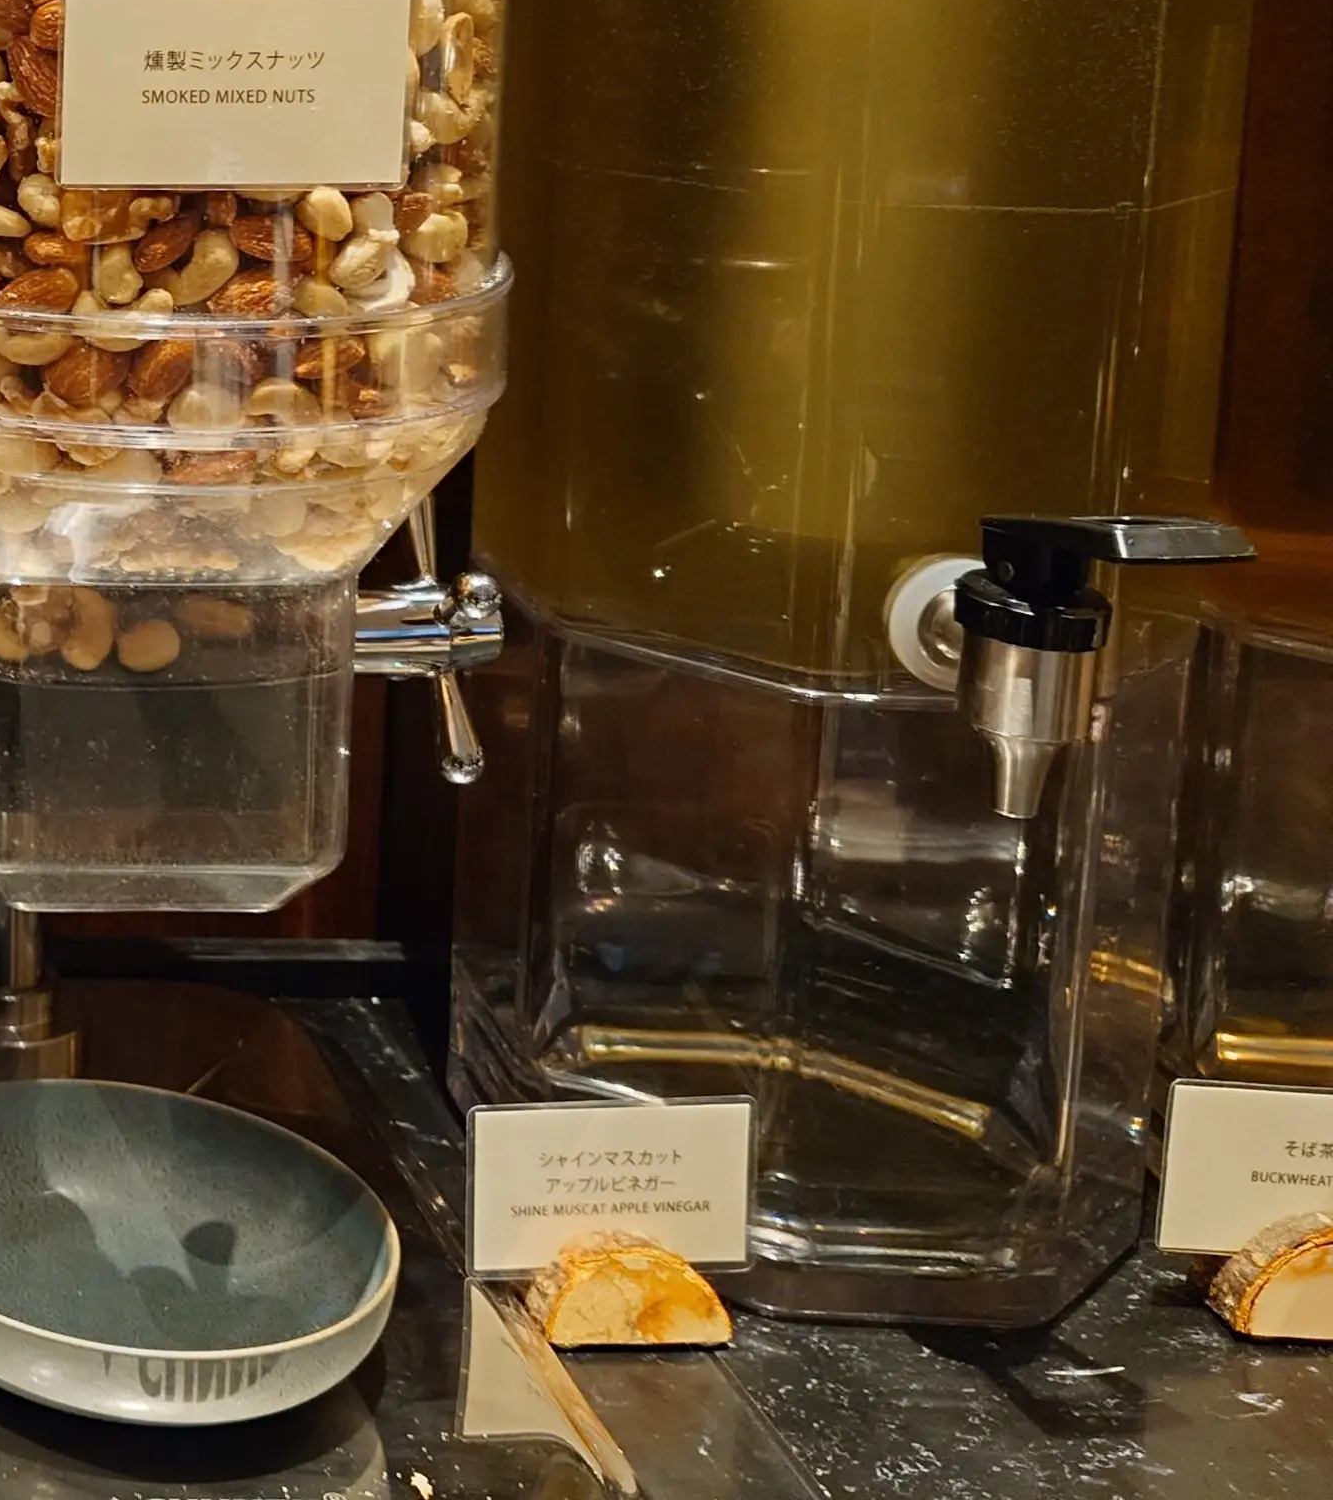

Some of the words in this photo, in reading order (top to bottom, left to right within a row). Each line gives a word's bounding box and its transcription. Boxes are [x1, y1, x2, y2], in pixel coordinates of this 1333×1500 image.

[143, 49, 325, 72] 燻製ミックスナッツ
[141, 88, 211, 105] SMOKED
[215, 88, 268, 105] MIXED
[272, 88, 316, 104] NUTS
[538, 1149, 683, 1168] シャインマスカット
[1284, 1139, 1333, 1159] そば茶
[545, 1175, 677, 1194] アップルビネガー
[1250, 1170, 1333, 1187] BUCKWHEAT
[510, 1204, 549, 1218] SHINE
[553, 1202, 607, 1217] MUSCAT
[610, 1202, 650, 1215] APPLE
[653, 1200, 711, 1214] VINEGAR
